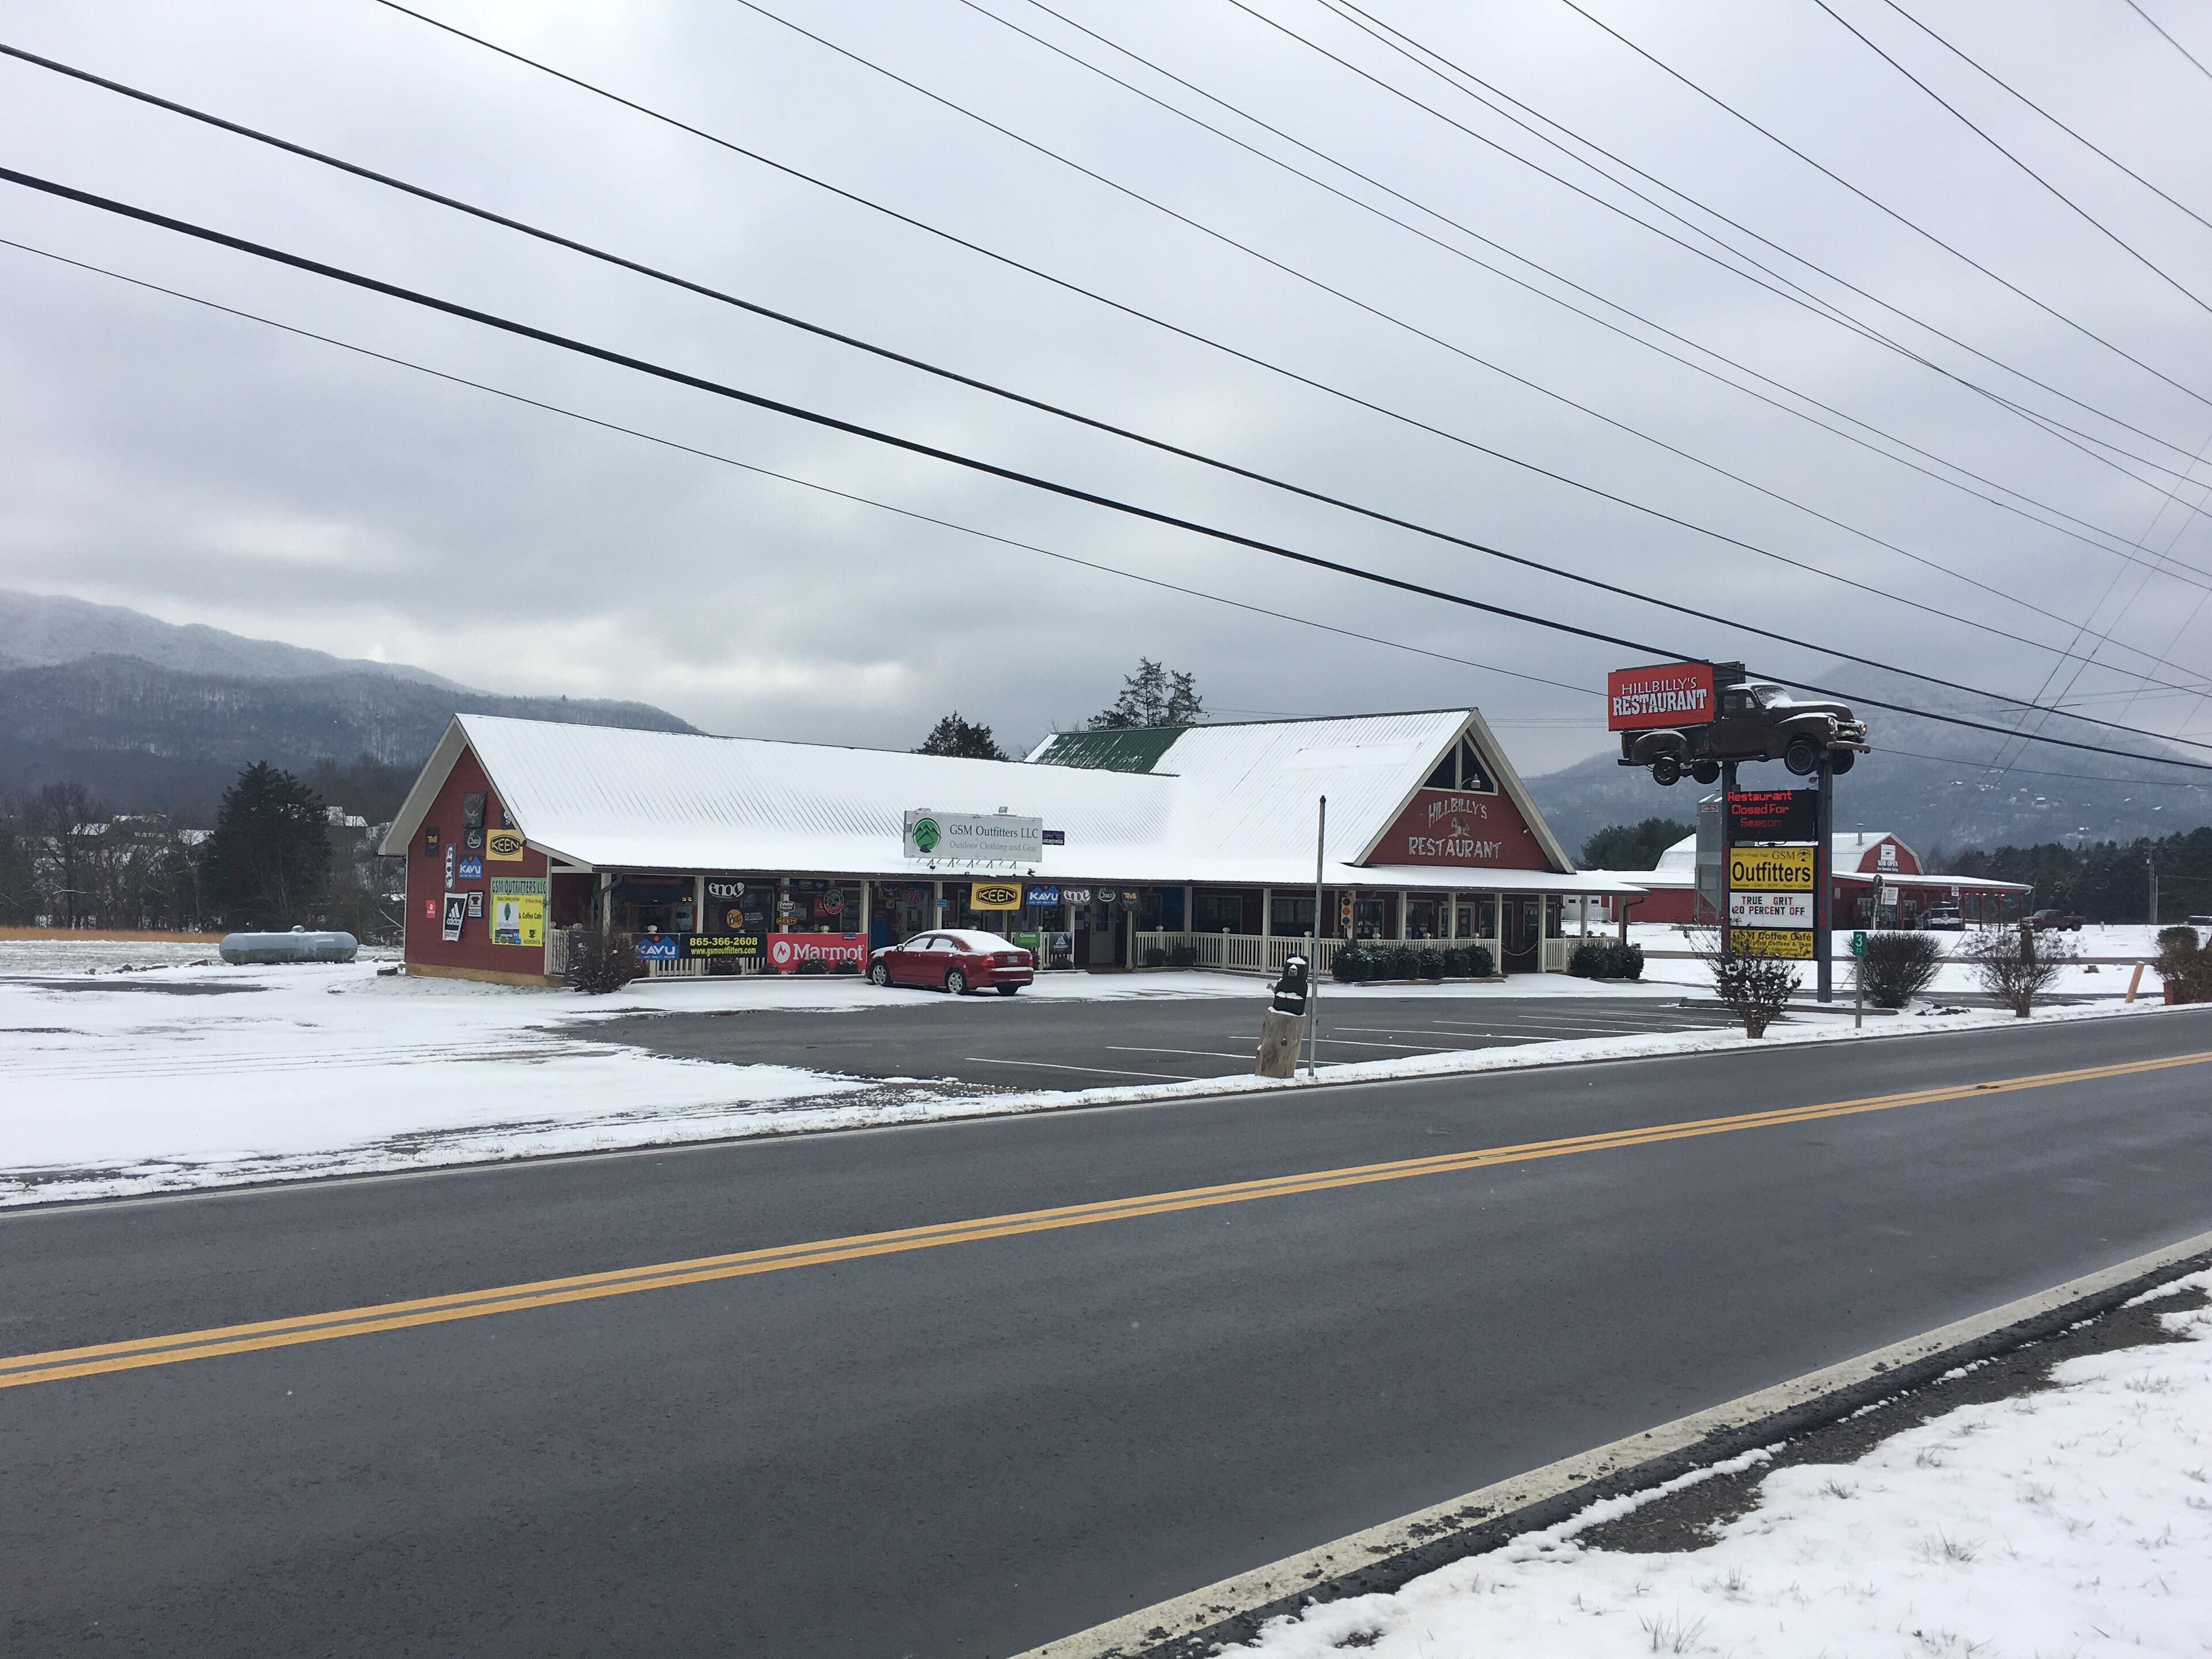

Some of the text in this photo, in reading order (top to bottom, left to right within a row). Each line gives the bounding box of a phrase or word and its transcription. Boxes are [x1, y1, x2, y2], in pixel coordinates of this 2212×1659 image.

[1622, 677, 1697, 695] HILLBILLY'S
[1613, 688, 1707, 716] RESTAURANT
[1728, 790, 1792, 801] Restaurant
[1428, 797, 1487, 828] HILLBILLY'S
[1732, 804, 1790, 815] Closed For
[1740, 818, 1781, 827] Season
[950, 824, 1038, 839] GSM Outfitters LLC
[492, 838, 518, 851] KEEN
[950, 840, 1037, 852] Outdoor Clothing and Gear
[1409, 837, 1502, 858] RESTAURANT
[1772, 851, 1796, 859] GSM
[460, 865, 481, 874] KAVU
[1732, 861, 1811, 882] Outfitters
[492, 880, 547, 894] GSM OUTFITTERS LLC
[979, 889, 1016, 902] KEEN
[1029, 892, 1058, 900] KAVU
[1742, 896, 1793, 905] TRUE GRIT
[1749, 906, 1785, 915] PERCENT
[1789, 907, 1805, 915] OFF
[690, 937, 758, 946] 865-366-2608
[1758, 931, 1787, 940] Coffee
[1791, 932, 1812, 941] Café
[1855, 934, 1862, 946] 3
[691, 946, 756, 957] www.gsmoutfitters.com
[793, 944, 863, 961] Marmot
